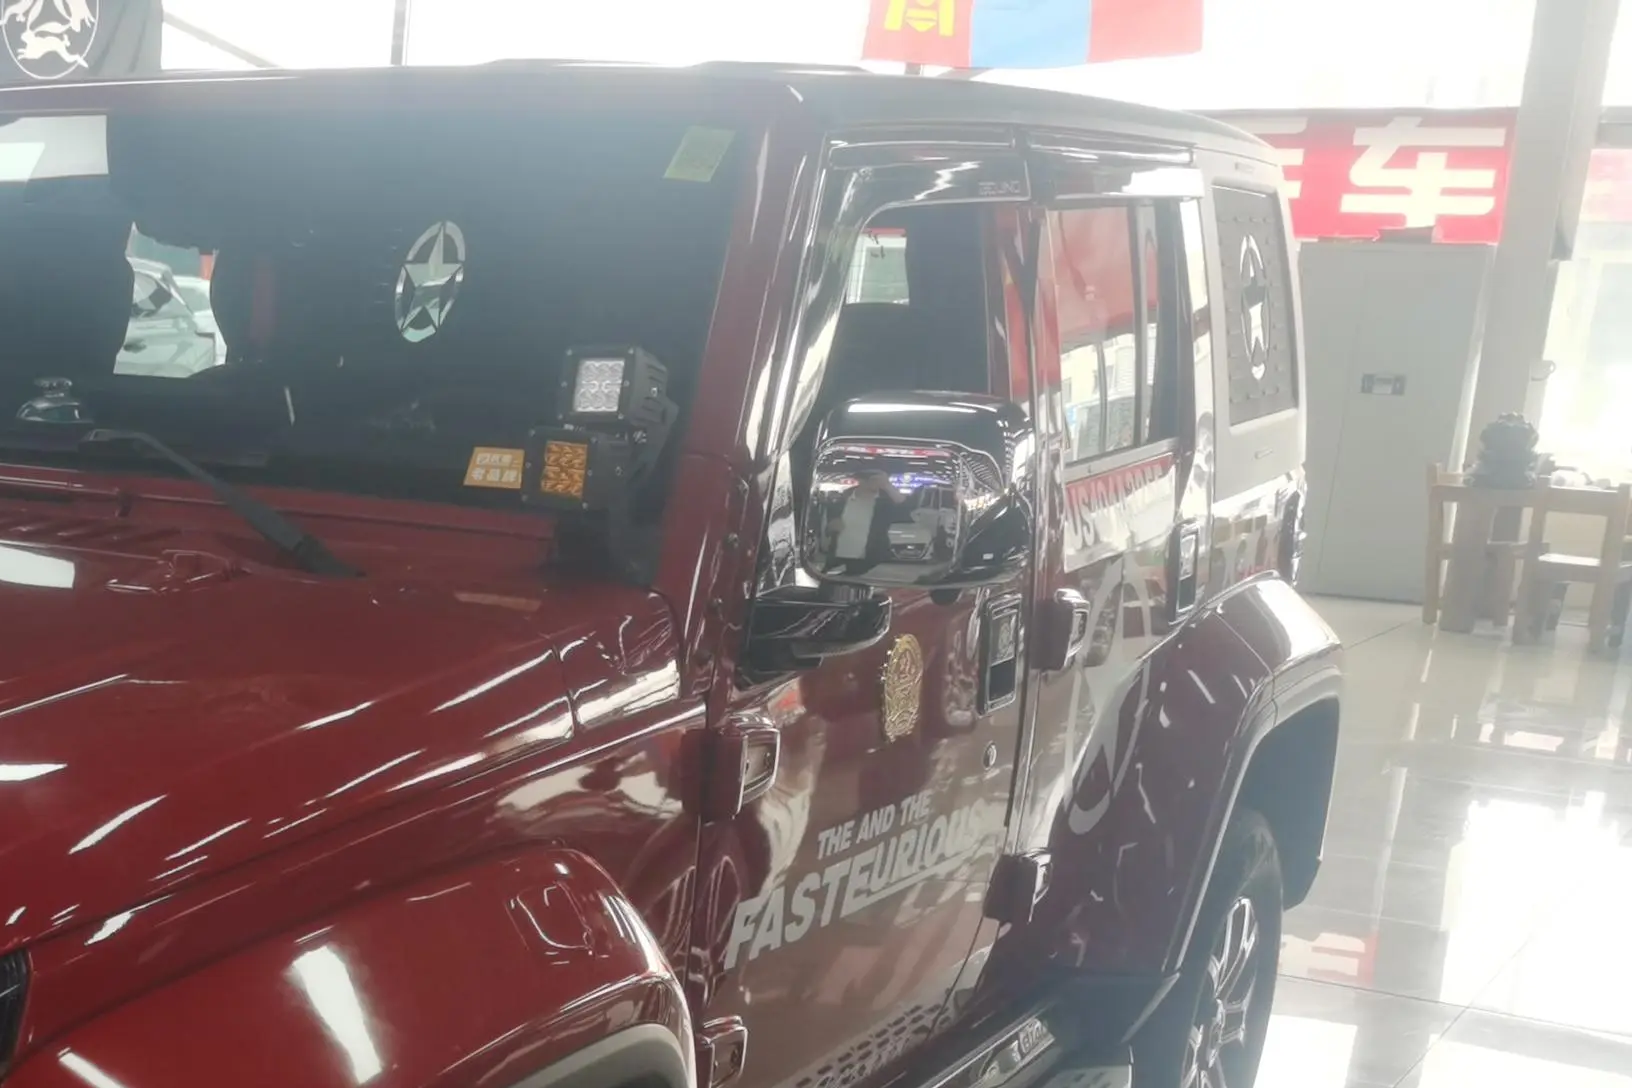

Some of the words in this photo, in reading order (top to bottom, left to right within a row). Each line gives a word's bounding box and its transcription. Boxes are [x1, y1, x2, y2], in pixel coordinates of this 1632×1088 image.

[817, 820, 855, 860] THE
[856, 804, 896, 844] AND
[900, 789, 935, 827] THE
